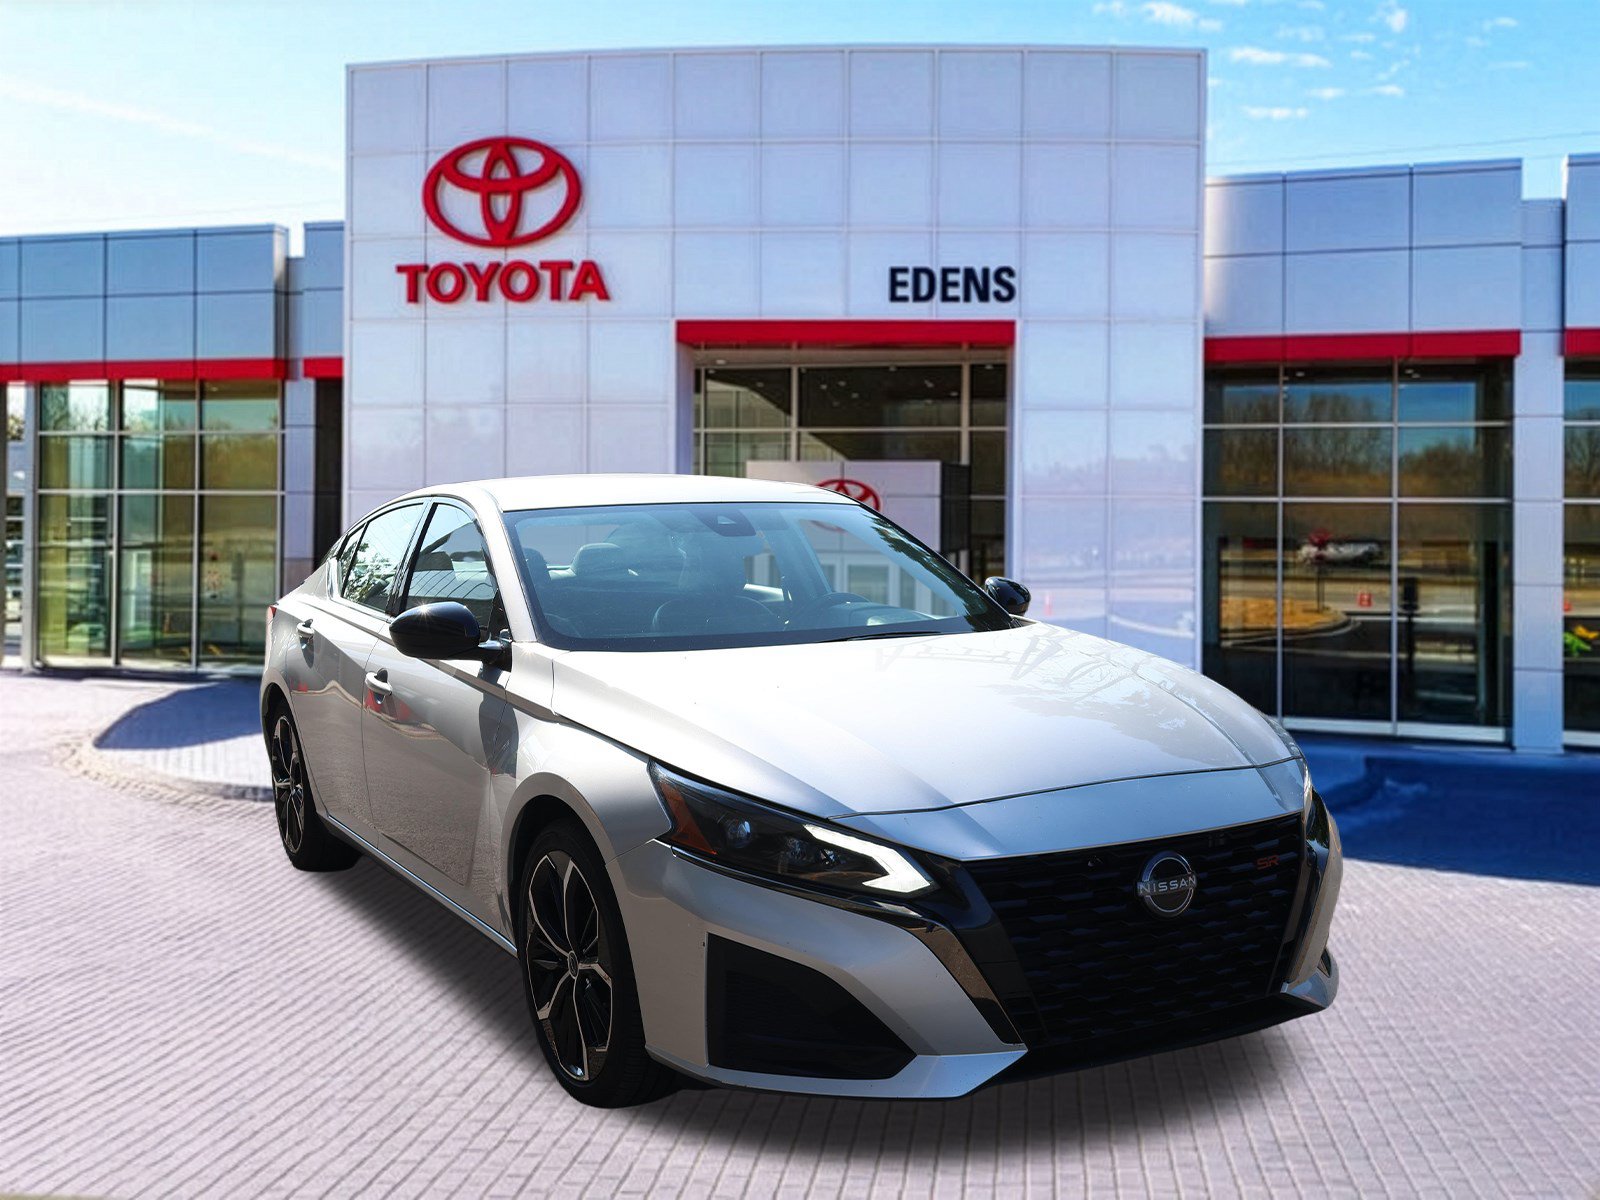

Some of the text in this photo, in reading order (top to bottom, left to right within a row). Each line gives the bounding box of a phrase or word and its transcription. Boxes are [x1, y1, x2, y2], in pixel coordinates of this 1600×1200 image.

[396, 260, 611, 304] TOYOTA
[889, 266, 1016, 303] EDENS
[1256, 854, 1280, 871] SR
[1138, 874, 1197, 895] NISSAN
